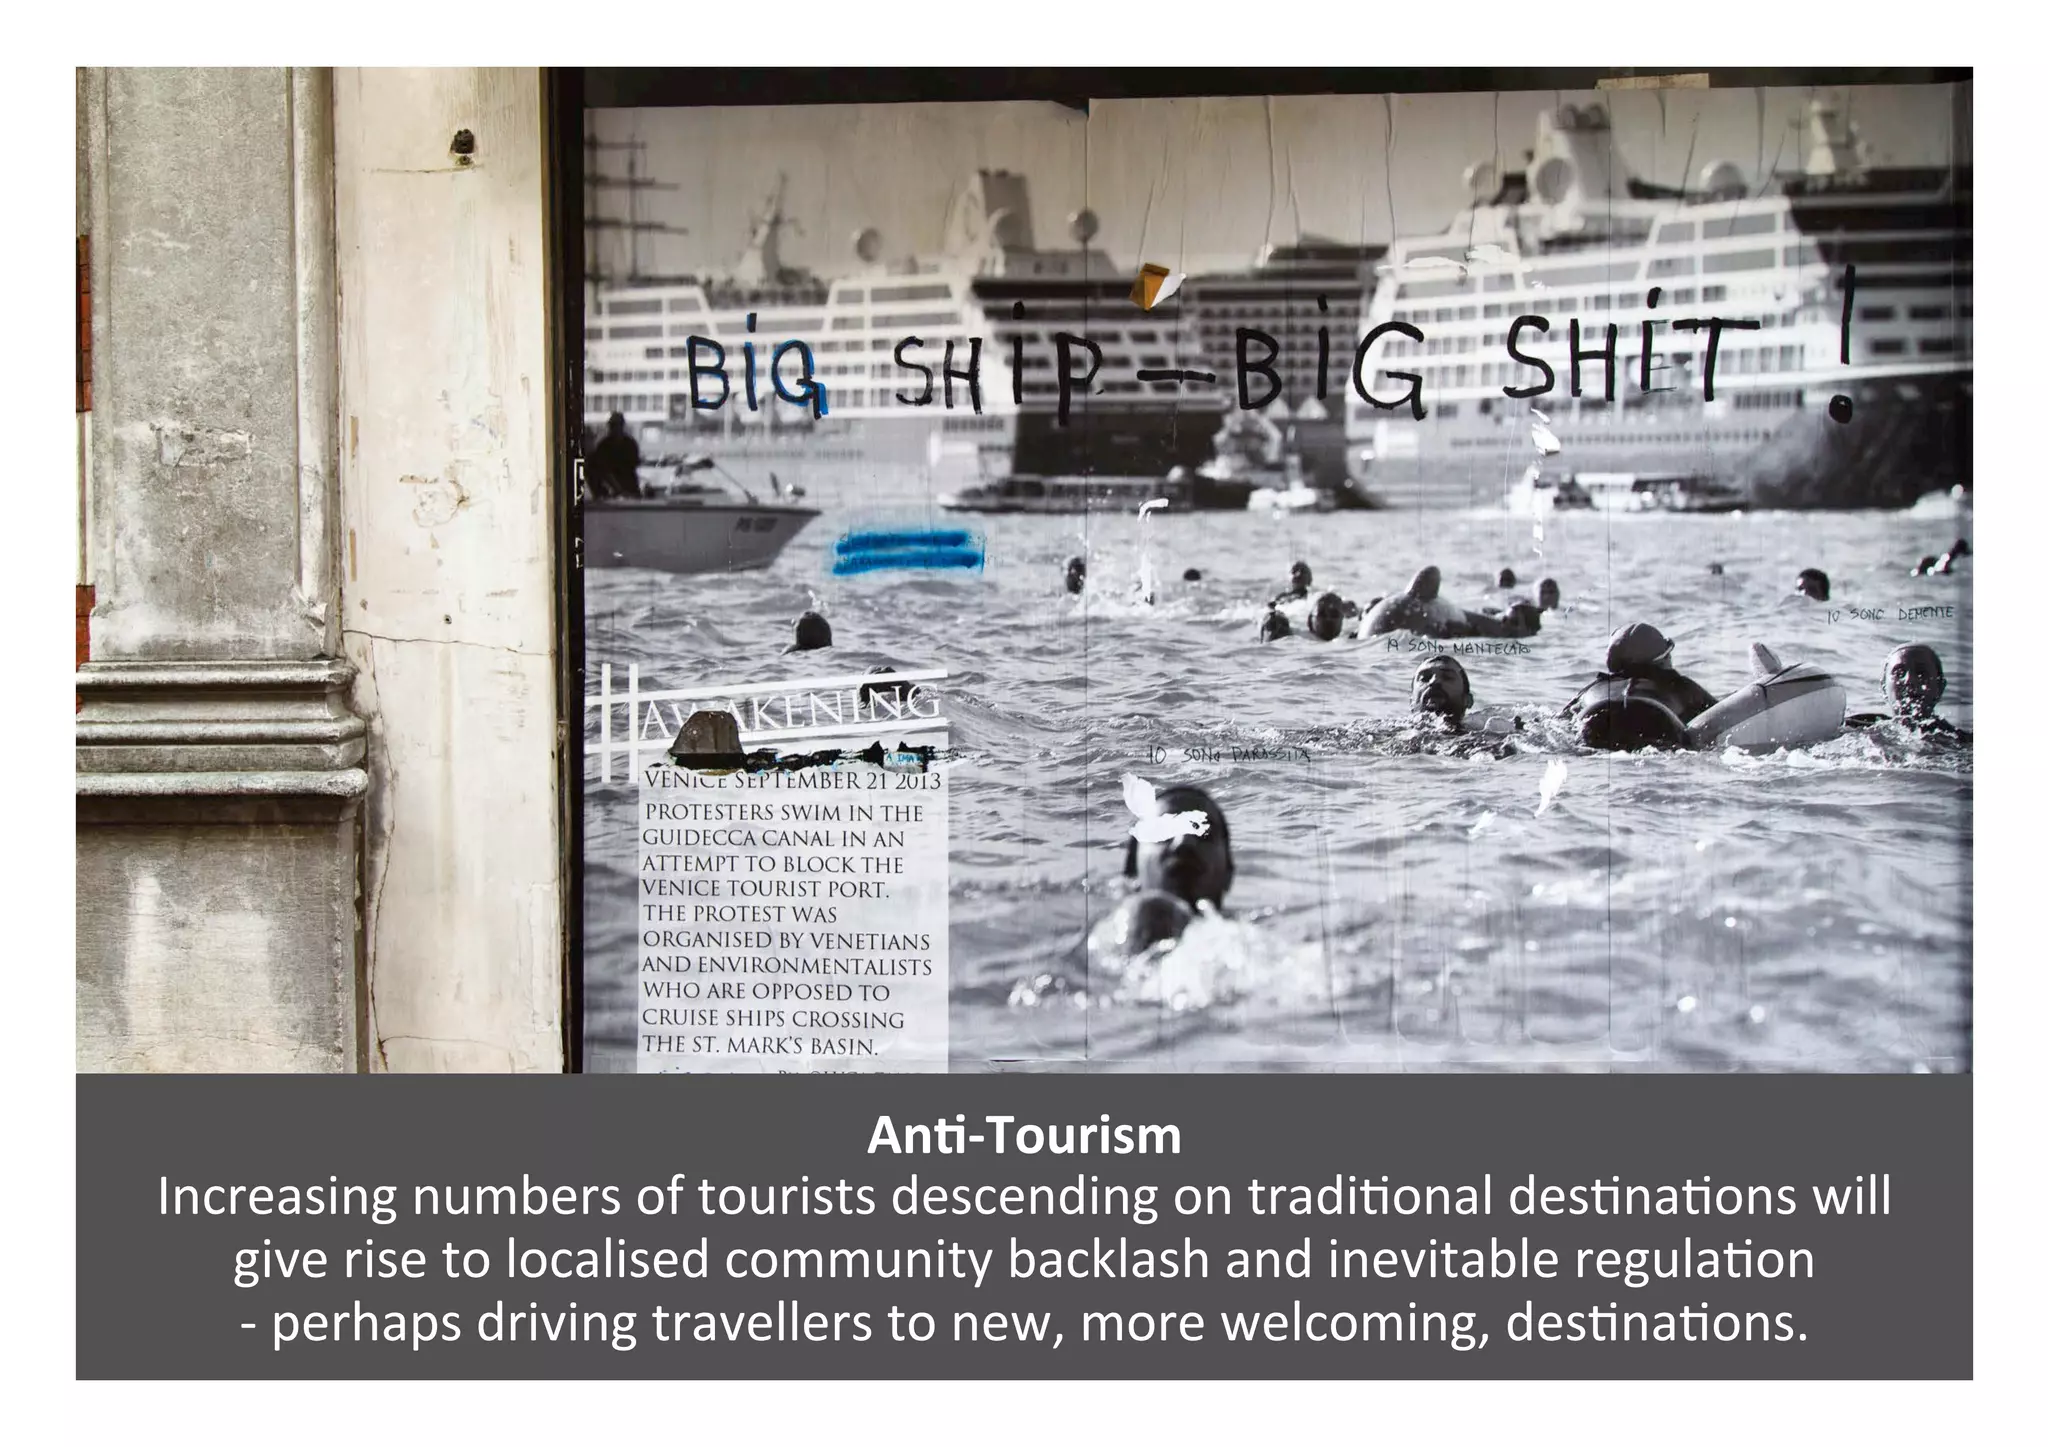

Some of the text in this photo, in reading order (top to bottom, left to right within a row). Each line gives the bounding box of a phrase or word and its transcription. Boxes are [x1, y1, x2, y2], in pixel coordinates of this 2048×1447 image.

[644, 769, 942, 790] VENICE SEPTEMBER 21 2013
[646, 802, 924, 823] PROTESTERS SWIM IN THE
[642, 828, 904, 848] GUIDECCA CANAL IN AN
[642, 854, 904, 874] ATTEMPT TO BLOCK THE
[641, 878, 890, 899] VENICE TOURIST PORT.
[643, 904, 837, 924] THE PROTEST WAS
[643, 930, 931, 951] ORGANISED BY VENETIANS
[641, 955, 932, 976] AND ENVIRONMENTALISTS
[643, 981, 891, 1002] WHO ARE OPPOSED TO
[642, 1008, 904, 1030] CRUISE SHIPS CROSSING
[641, 1034, 878, 1056] THE ST. MARK'S BASIN.
